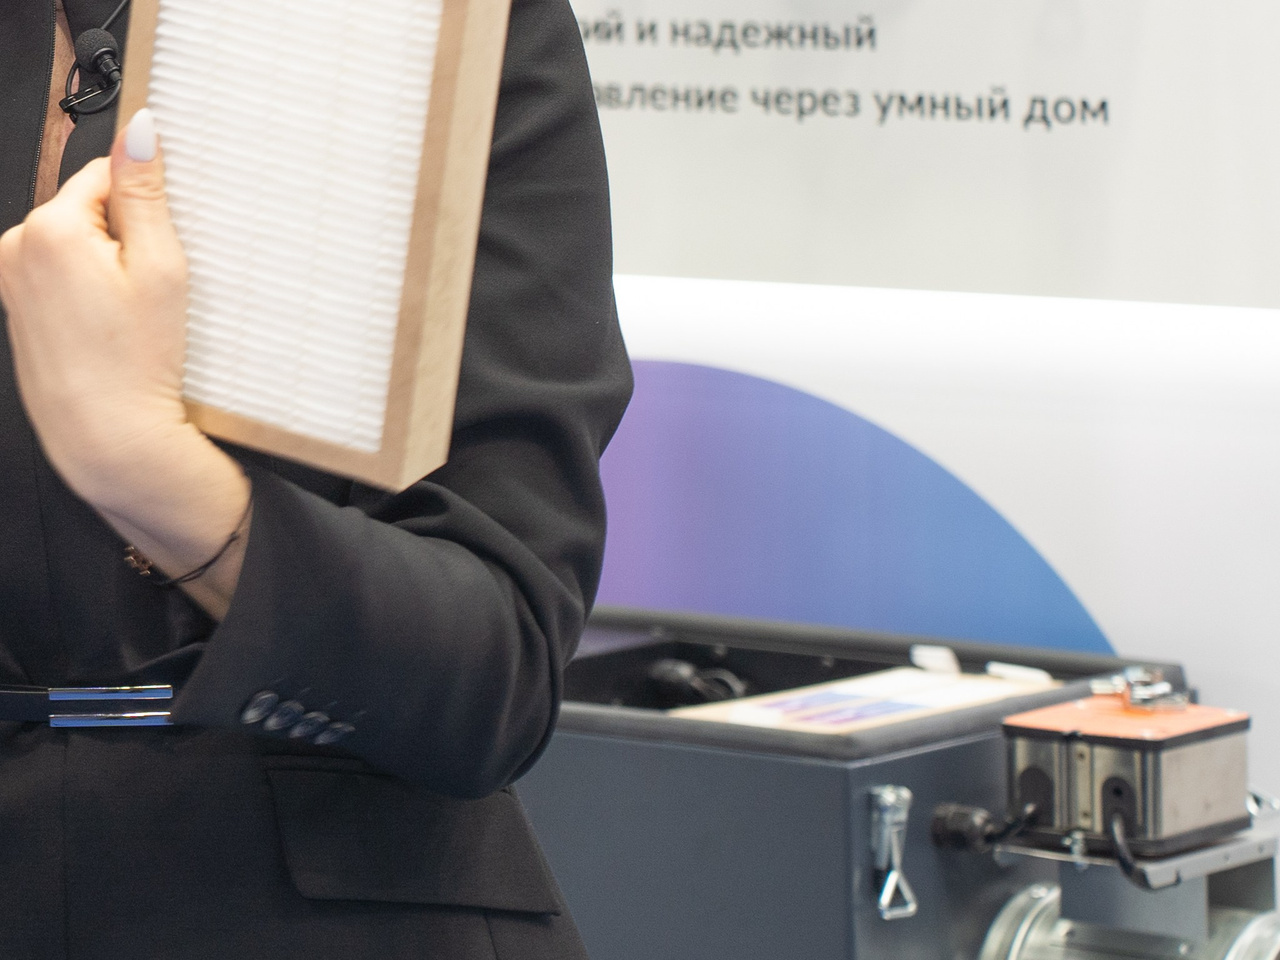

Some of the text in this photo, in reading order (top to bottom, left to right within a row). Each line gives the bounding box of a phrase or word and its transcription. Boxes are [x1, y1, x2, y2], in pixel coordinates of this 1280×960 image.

[634, 20, 658, 44] и
[670, 13, 877, 54] надежный
[593, 83, 1109, 129] вление через умный дом
